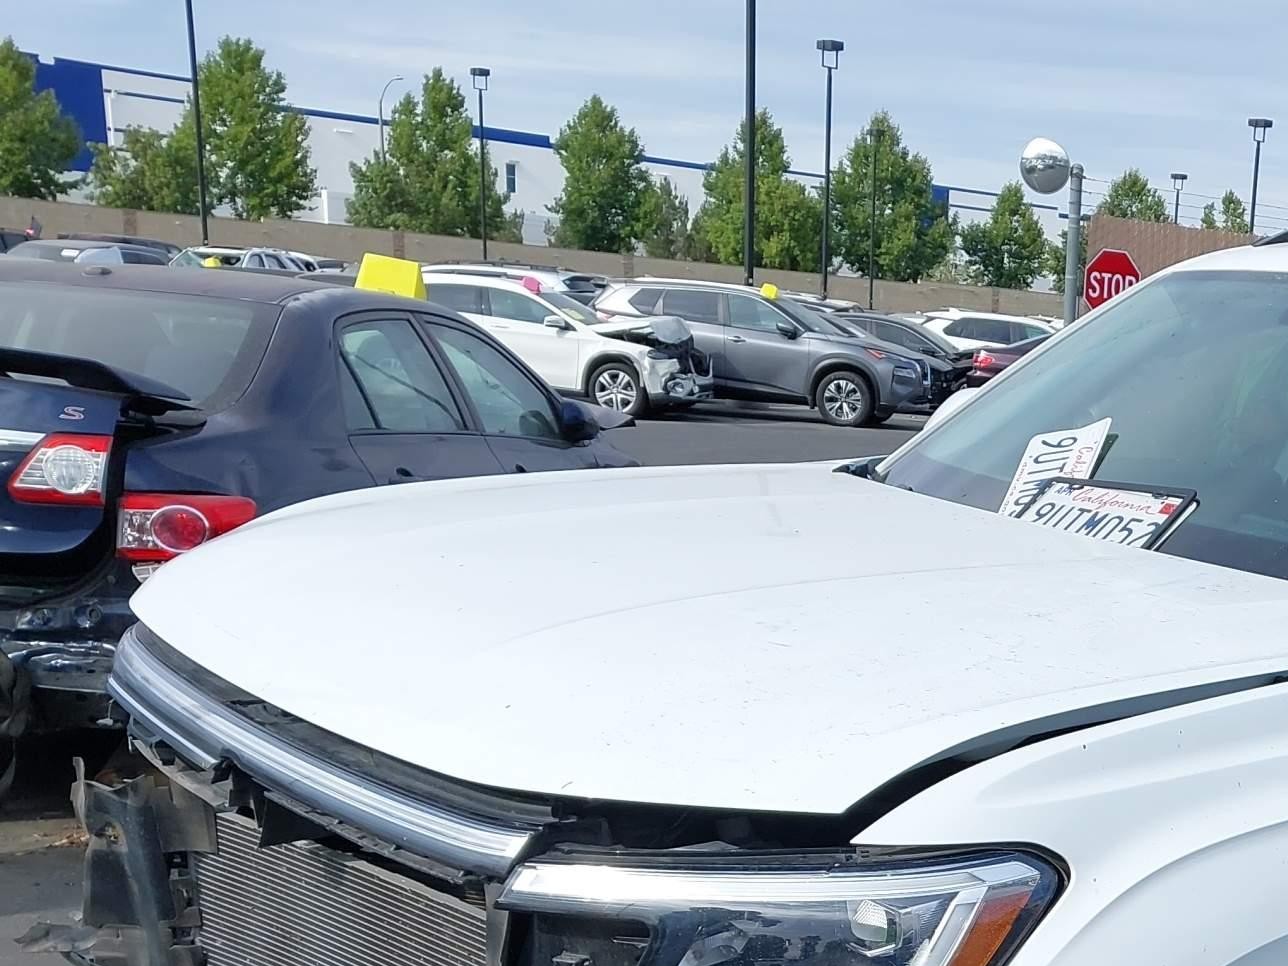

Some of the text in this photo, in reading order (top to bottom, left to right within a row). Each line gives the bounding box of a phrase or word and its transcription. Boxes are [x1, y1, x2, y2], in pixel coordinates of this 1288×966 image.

[1088, 271, 1137, 299] STOP
[58, 406, 85, 420] S
[1072, 486, 1157, 516] California
